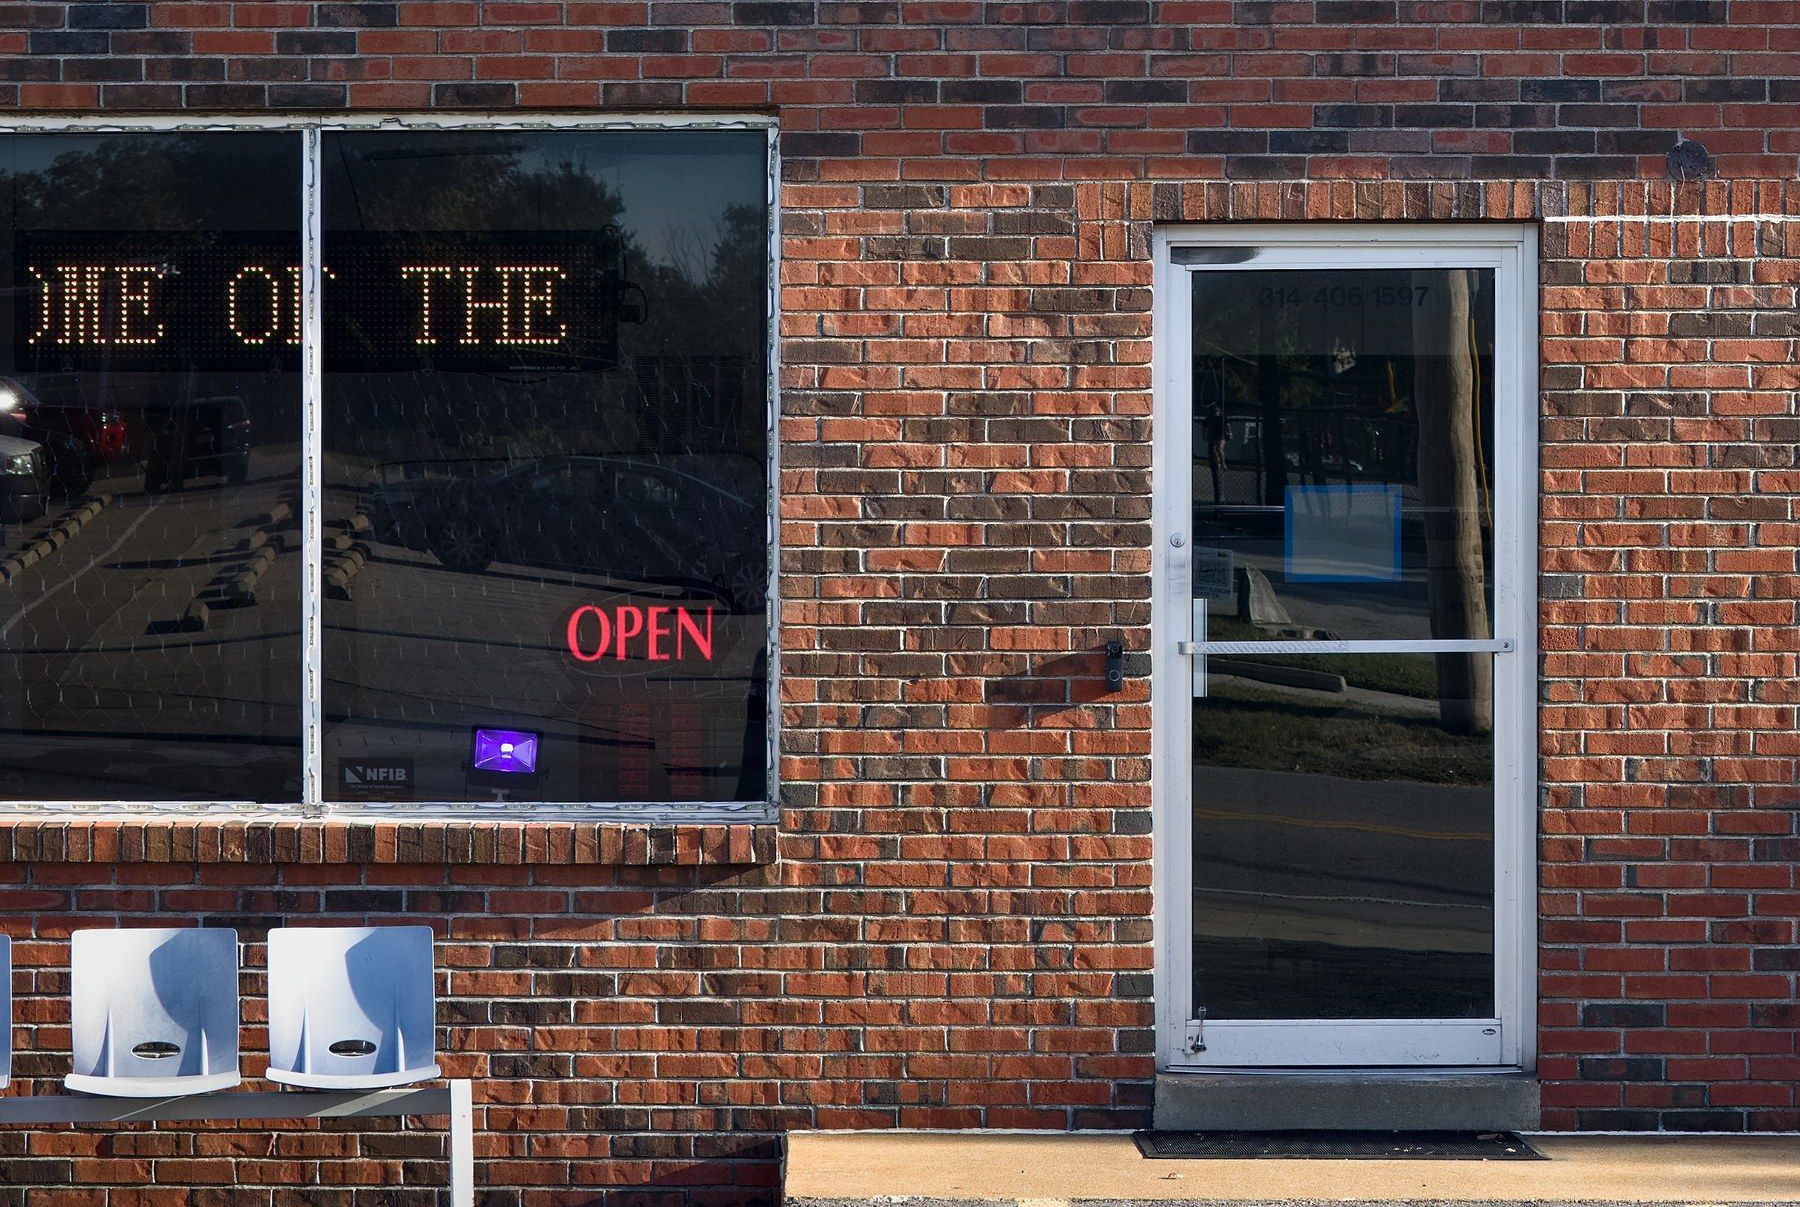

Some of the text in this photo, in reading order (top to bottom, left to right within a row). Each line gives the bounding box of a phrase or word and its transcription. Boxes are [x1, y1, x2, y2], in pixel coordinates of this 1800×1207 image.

[402, 266, 567, 344] THE
[567, 604, 714, 663] OPEN
[366, 767, 407, 781] NFIB
